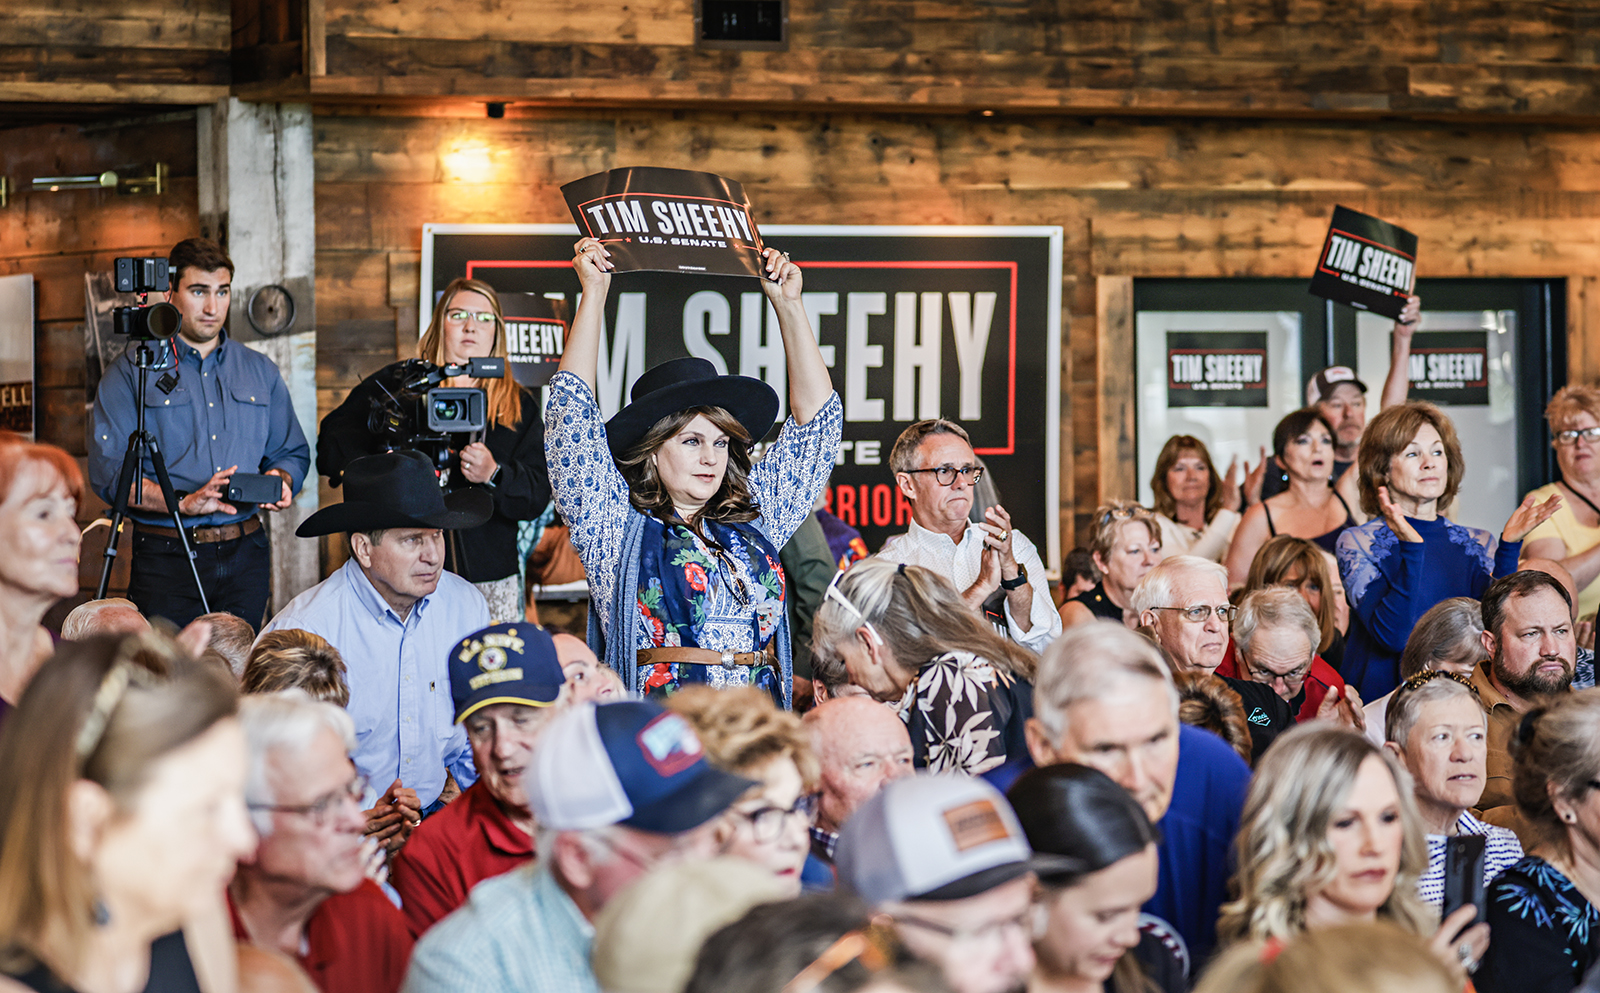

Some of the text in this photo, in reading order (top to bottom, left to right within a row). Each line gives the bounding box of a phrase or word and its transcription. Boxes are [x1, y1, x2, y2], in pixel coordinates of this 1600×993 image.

[587, 200, 753, 242] TIM SHEEHY
[638, 235, 728, 249] U.S. SENATE
[1325, 235, 1413, 291] TIM SHEEHY
[504, 323, 564, 356] HEEHY
[1170, 354, 1263, 383] TIM SHEEHY
[1427, 353, 1483, 382] SHEEHY
